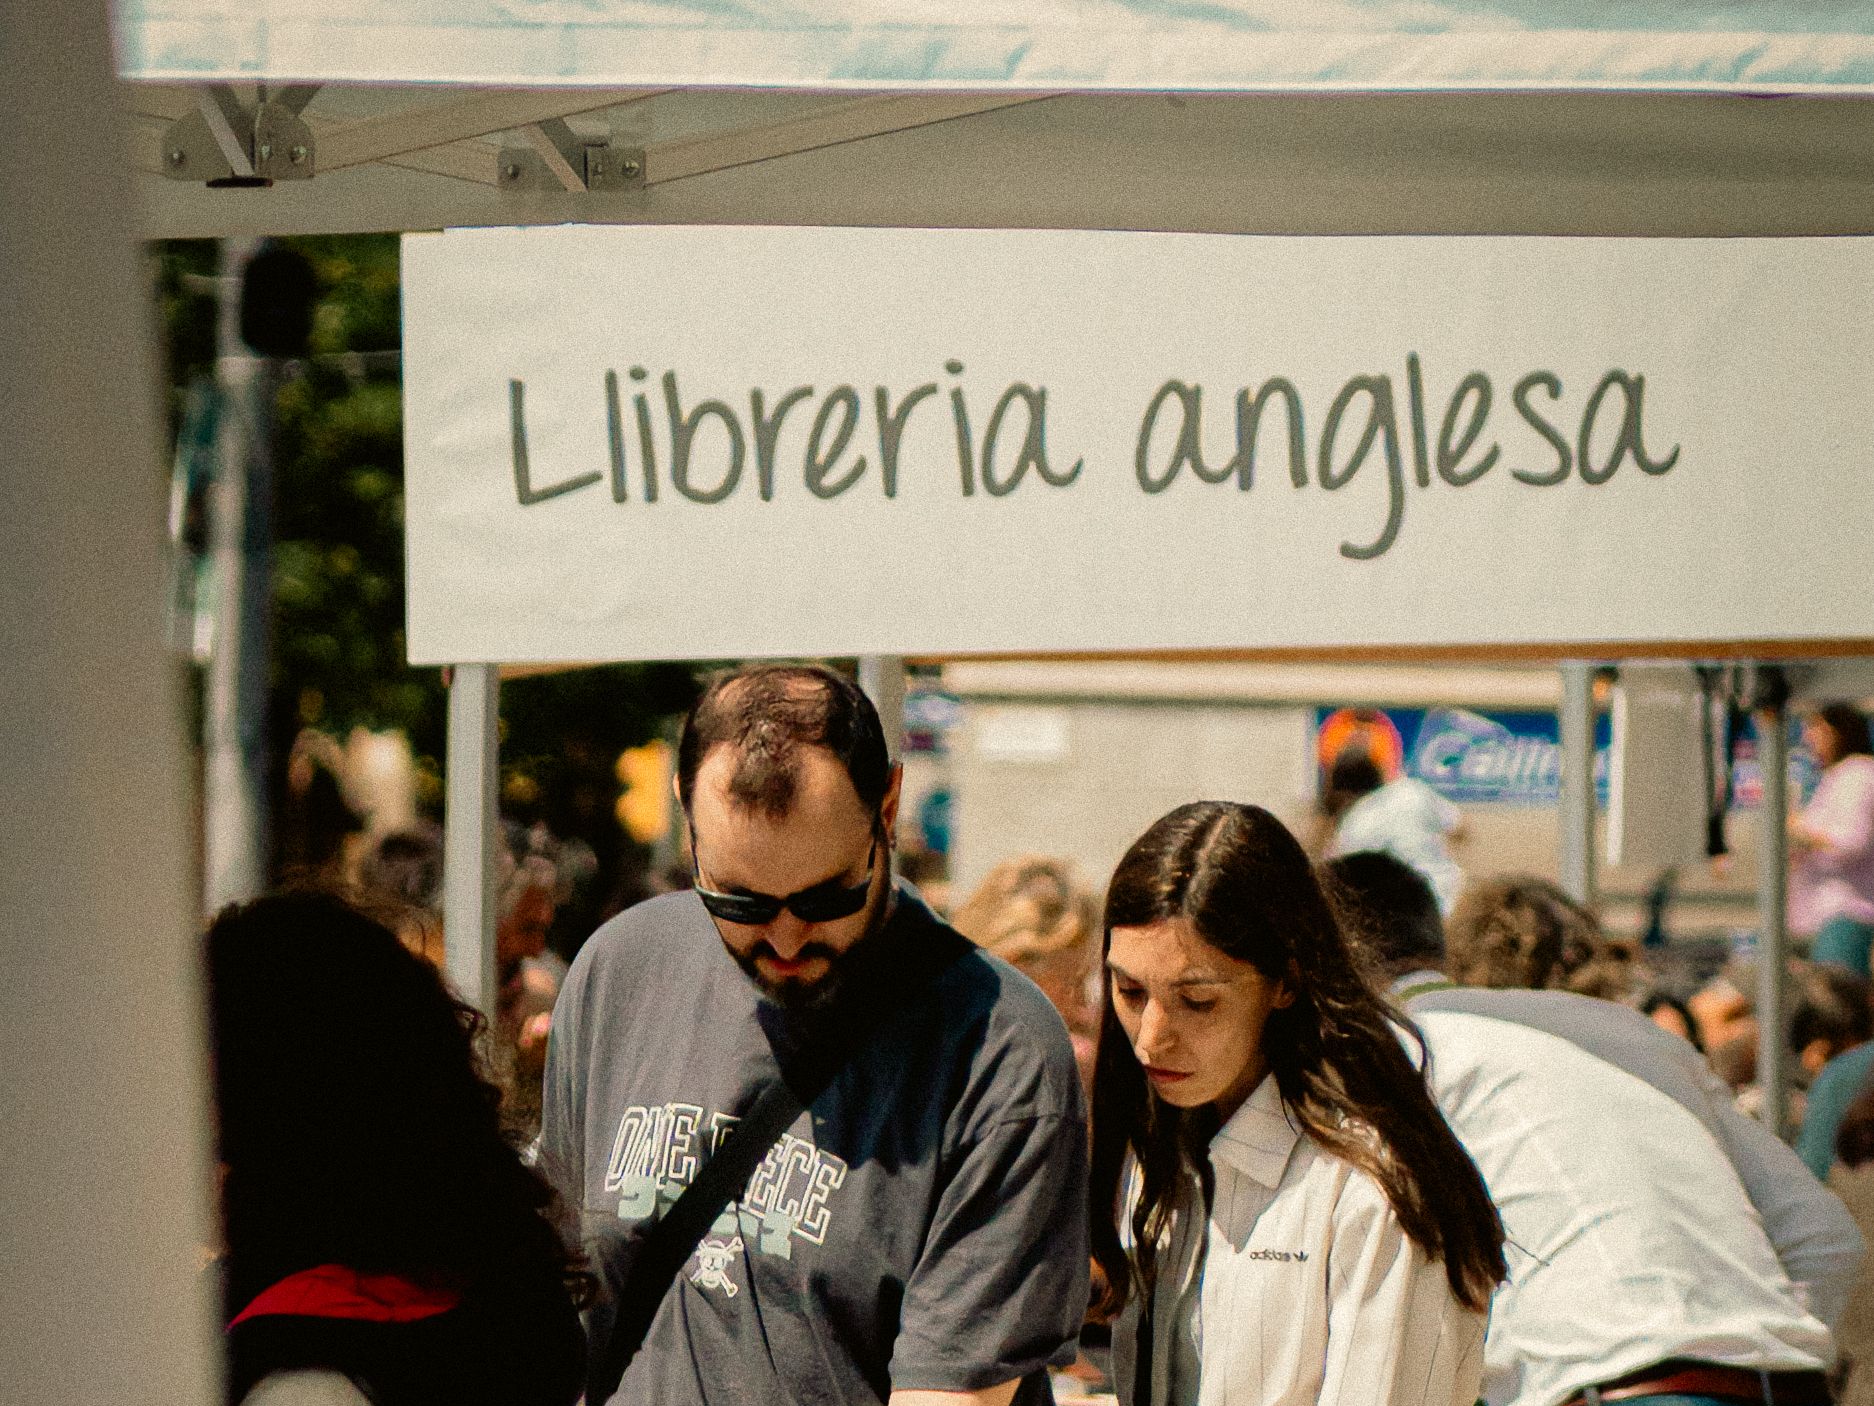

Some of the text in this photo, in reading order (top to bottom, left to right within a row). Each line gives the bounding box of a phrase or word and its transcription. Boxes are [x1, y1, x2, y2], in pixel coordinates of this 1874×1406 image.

[509, 351, 1681, 561] Llibreria anglesa
[604, 1102, 704, 1192] ONE
[711, 1112, 849, 1248] ECE
